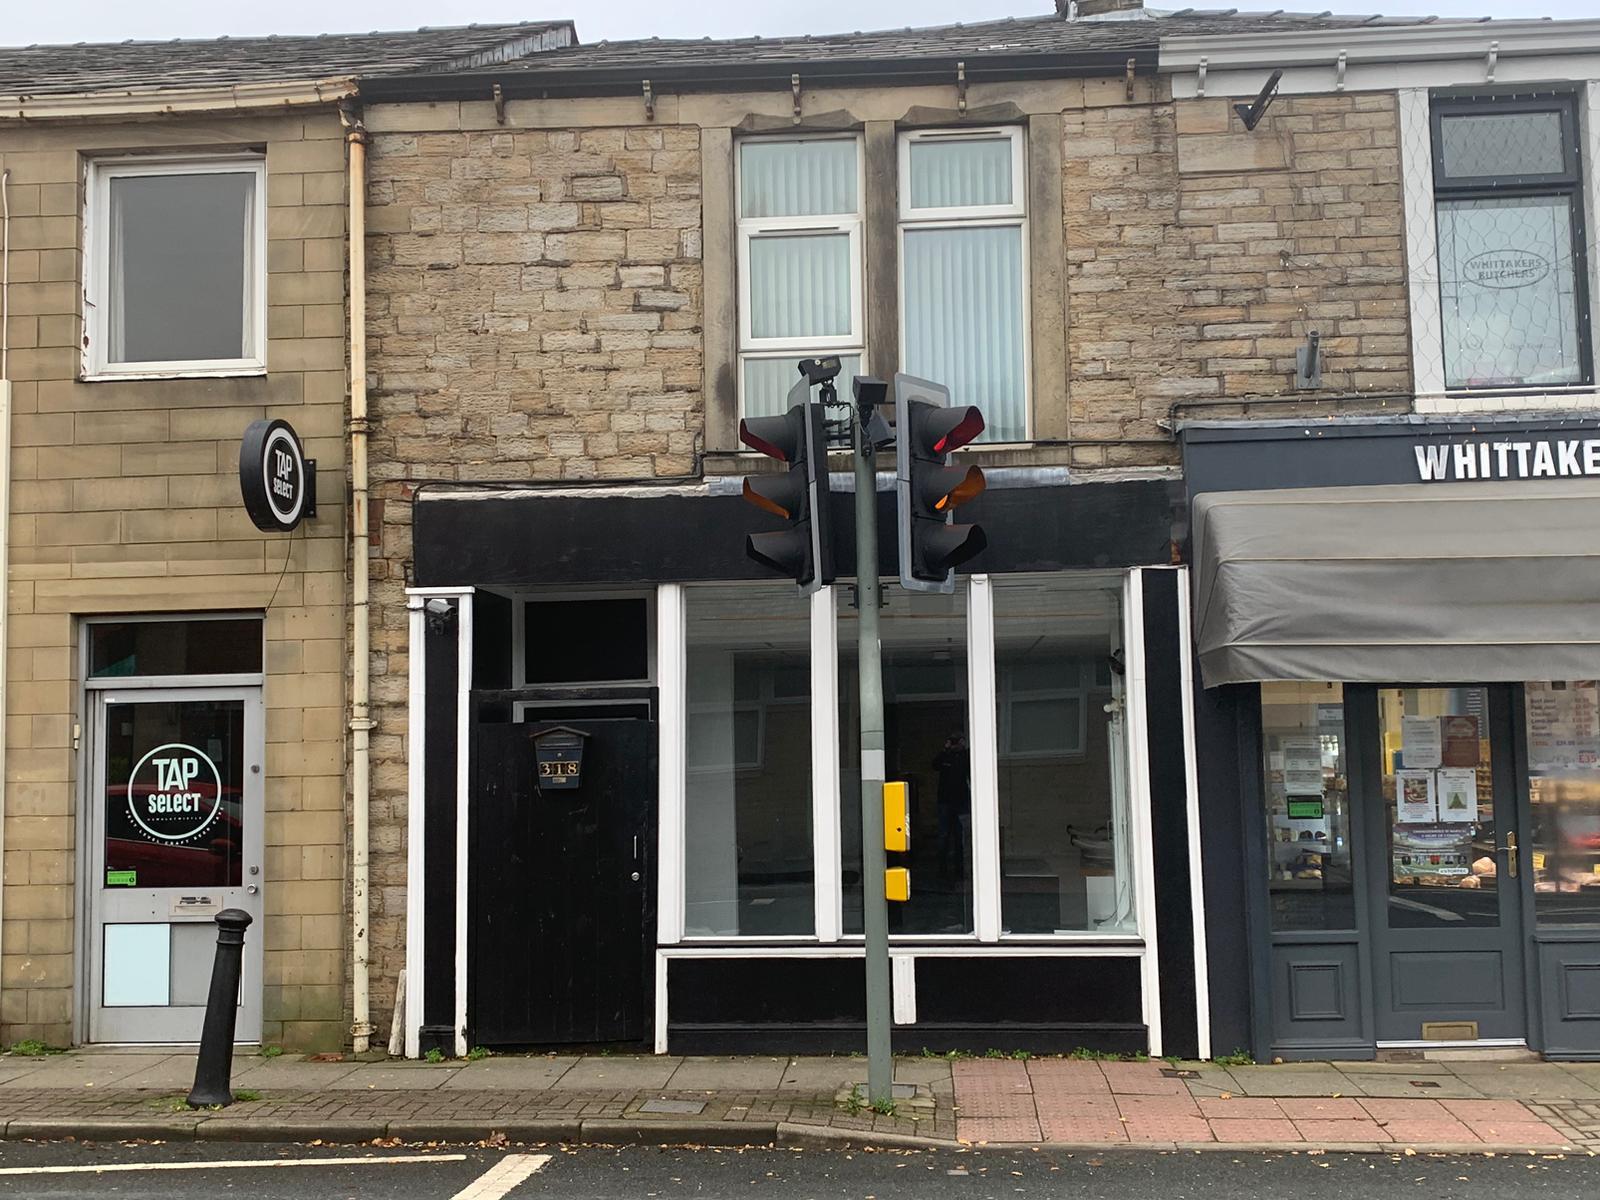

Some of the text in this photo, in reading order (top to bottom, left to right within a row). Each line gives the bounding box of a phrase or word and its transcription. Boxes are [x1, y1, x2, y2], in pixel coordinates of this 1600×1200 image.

[275, 449, 293, 481] TAP
[1414, 439, 1600, 481] WHITTAKE
[152, 758, 199, 791] TAP
[542, 763, 577, 775] 318
